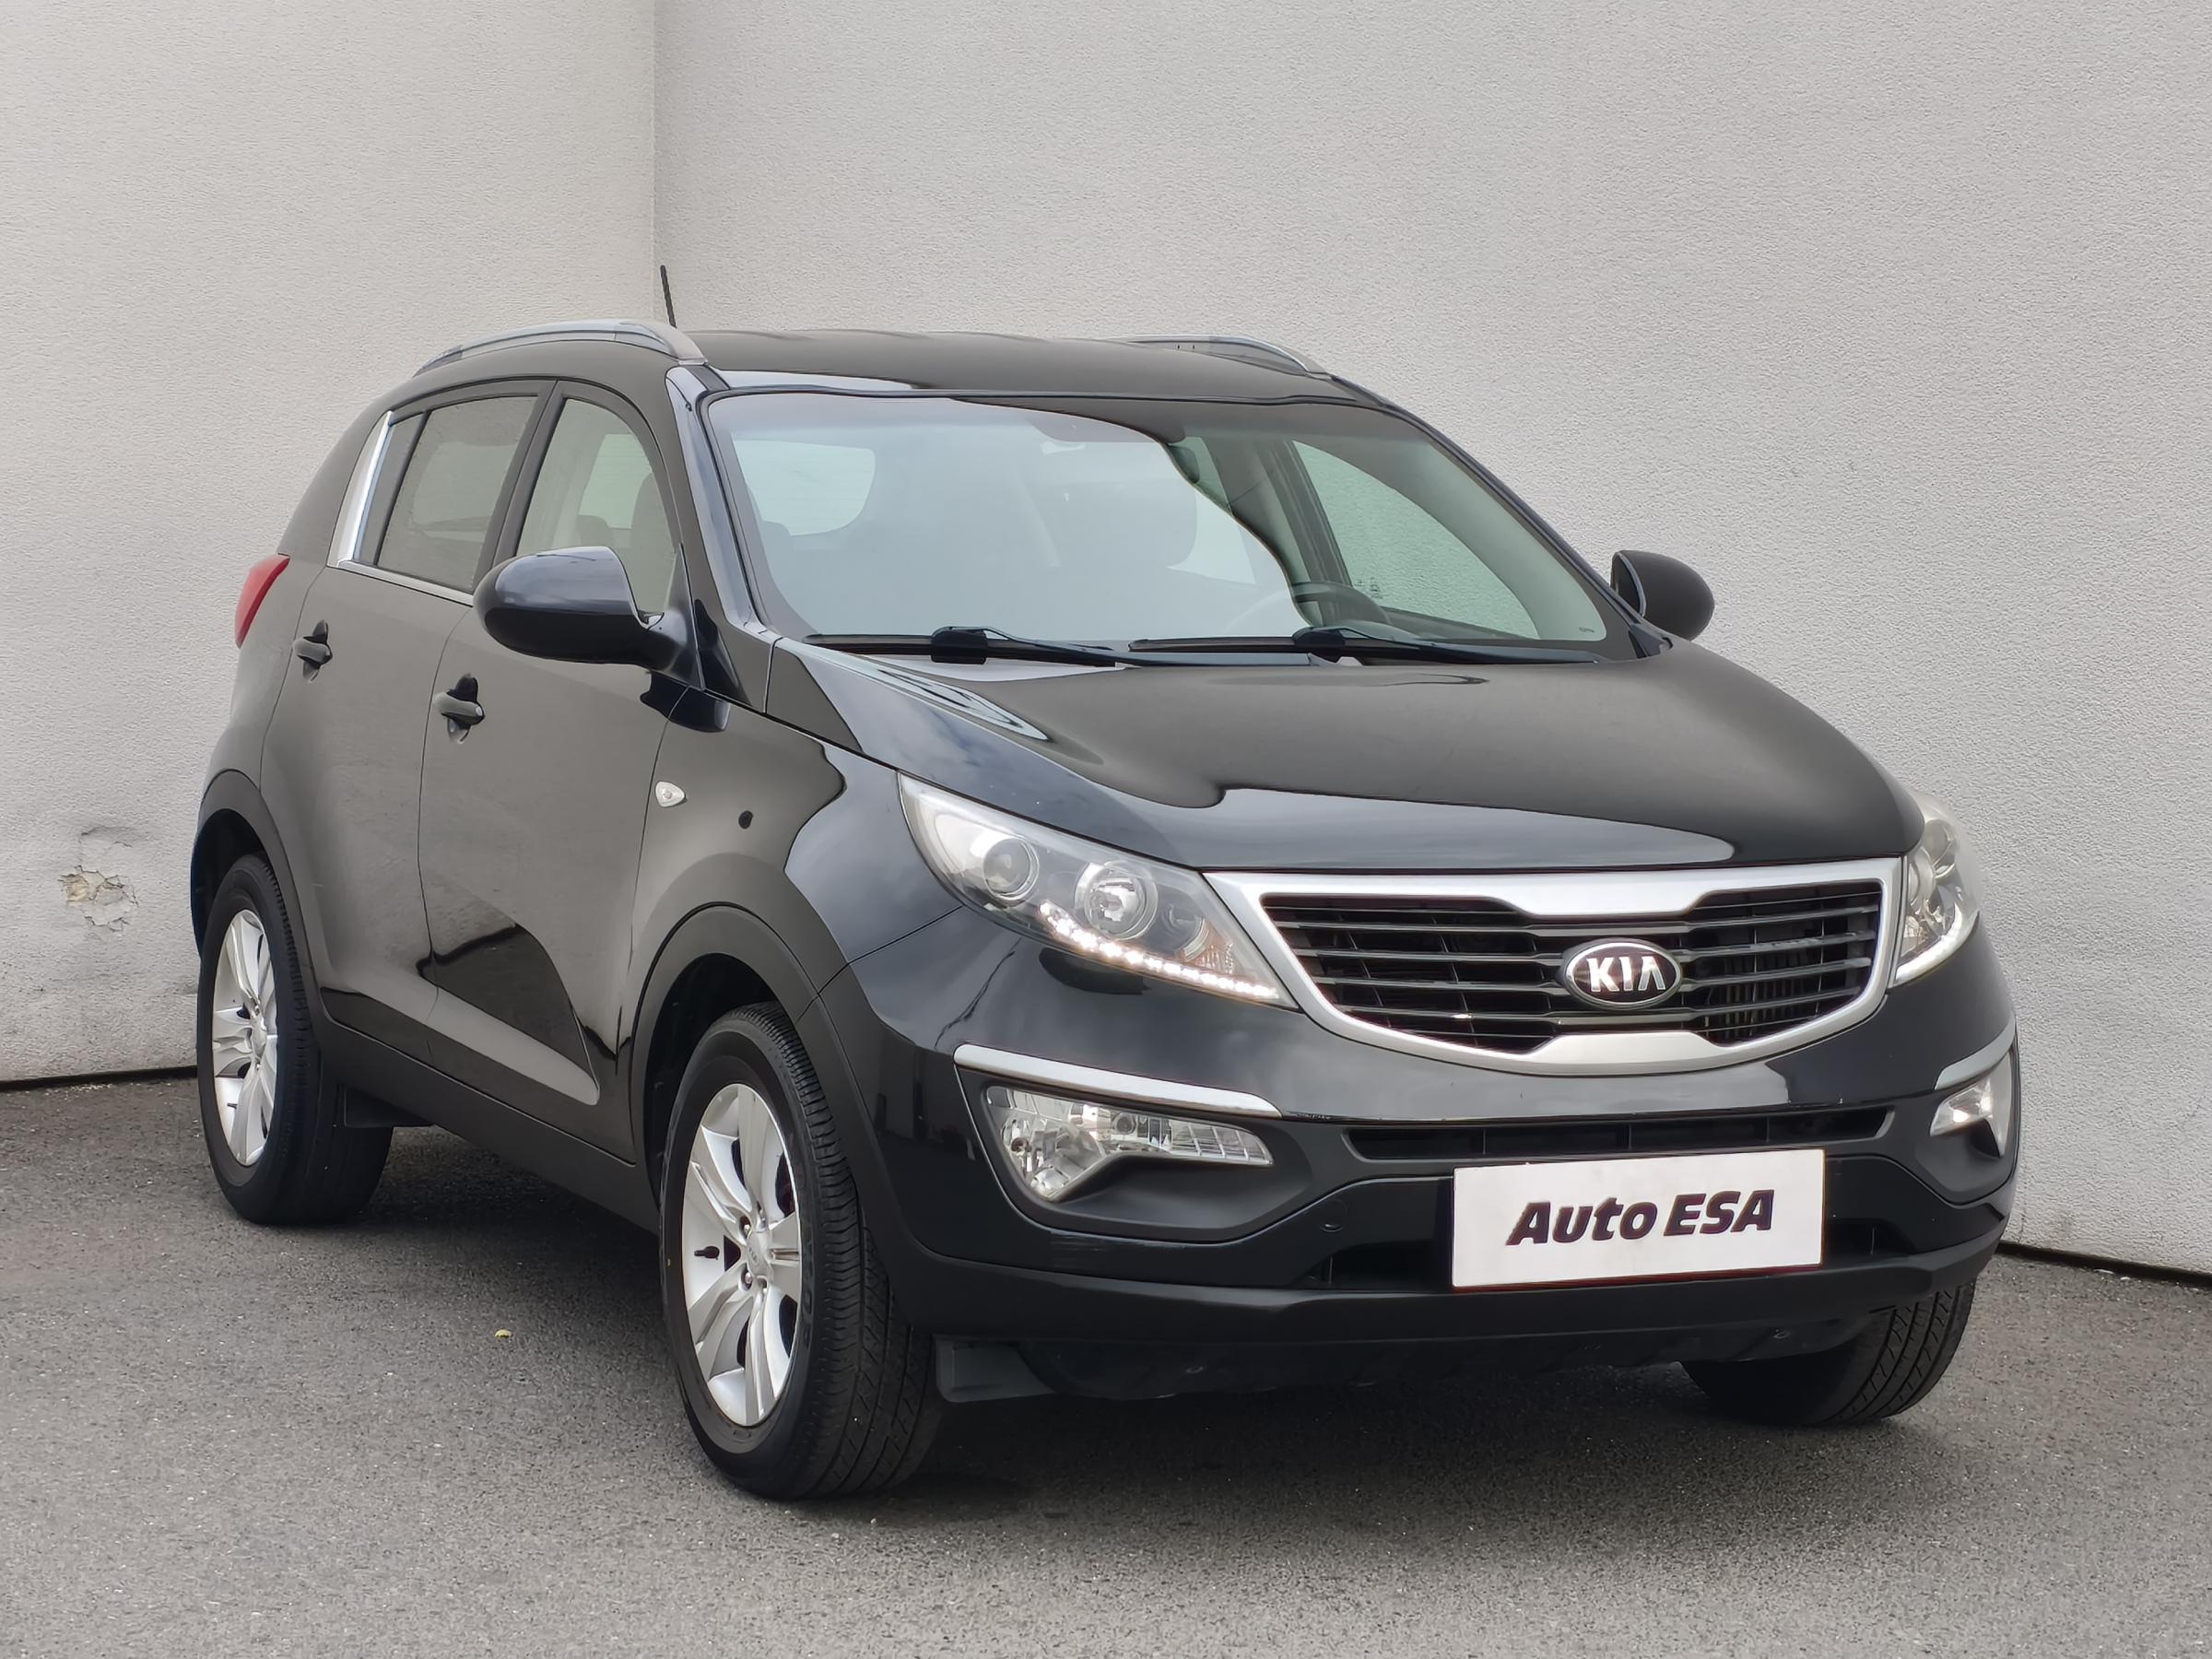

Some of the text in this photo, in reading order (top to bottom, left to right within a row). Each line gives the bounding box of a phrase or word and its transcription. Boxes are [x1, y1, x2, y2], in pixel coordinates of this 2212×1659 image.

[1586, 956, 1665, 992] KIA
[1505, 1189, 1774, 1245] Auto ESA
